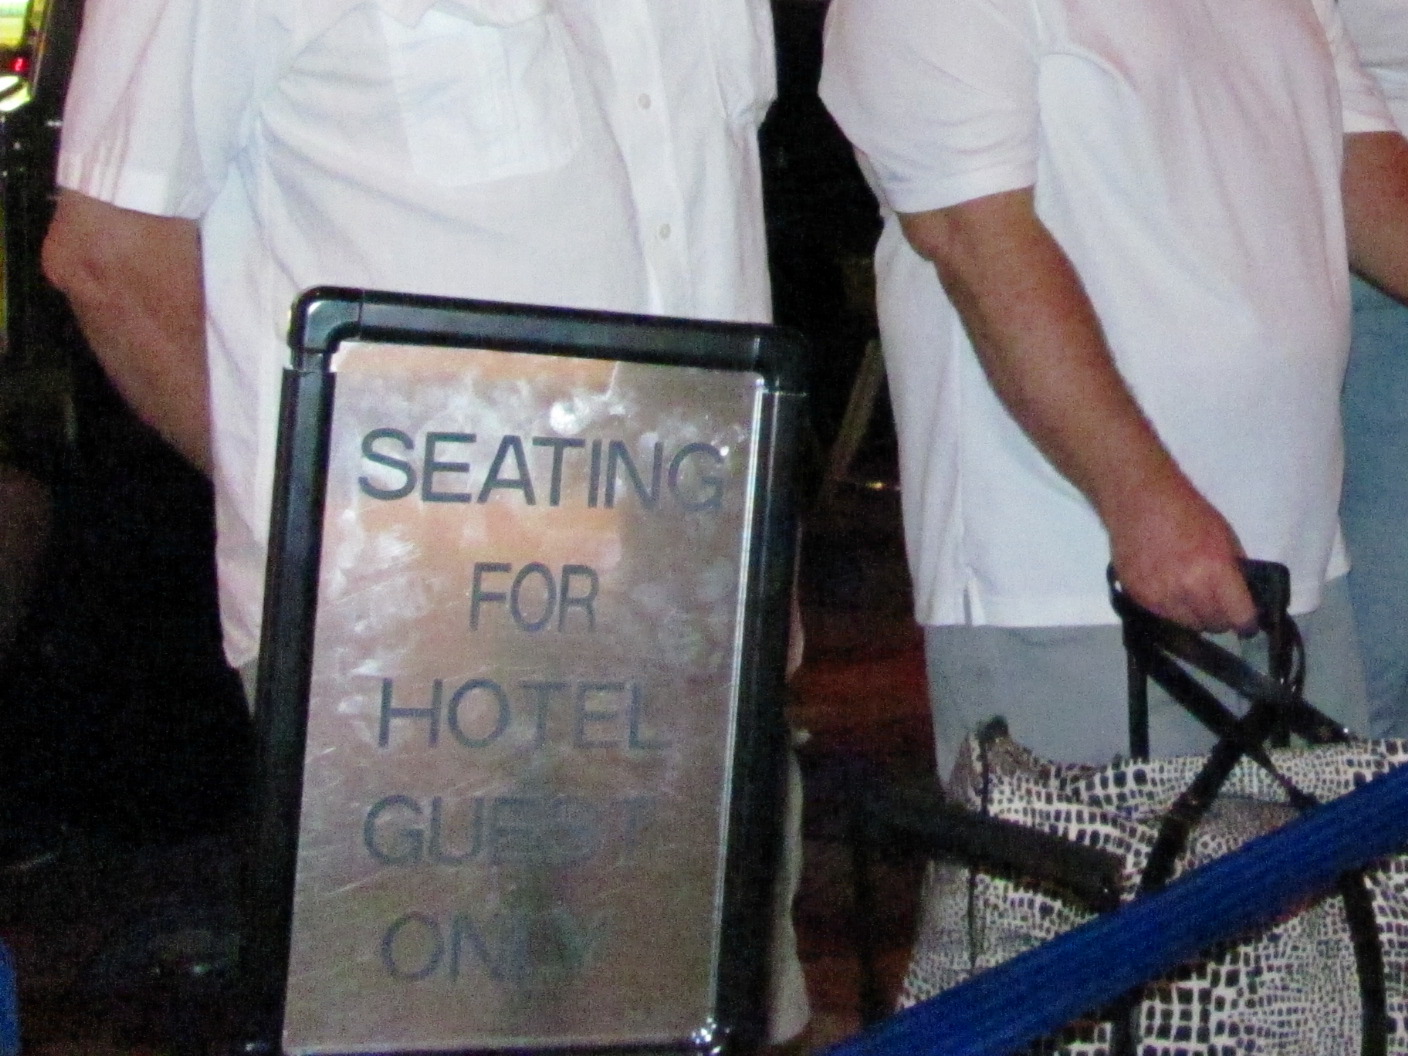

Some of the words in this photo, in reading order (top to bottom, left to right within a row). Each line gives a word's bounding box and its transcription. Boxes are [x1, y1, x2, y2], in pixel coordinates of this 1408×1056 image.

[357, 427, 726, 513] SEATING
[469, 561, 600, 633] FOR
[377, 677, 665, 751] HOTEL
